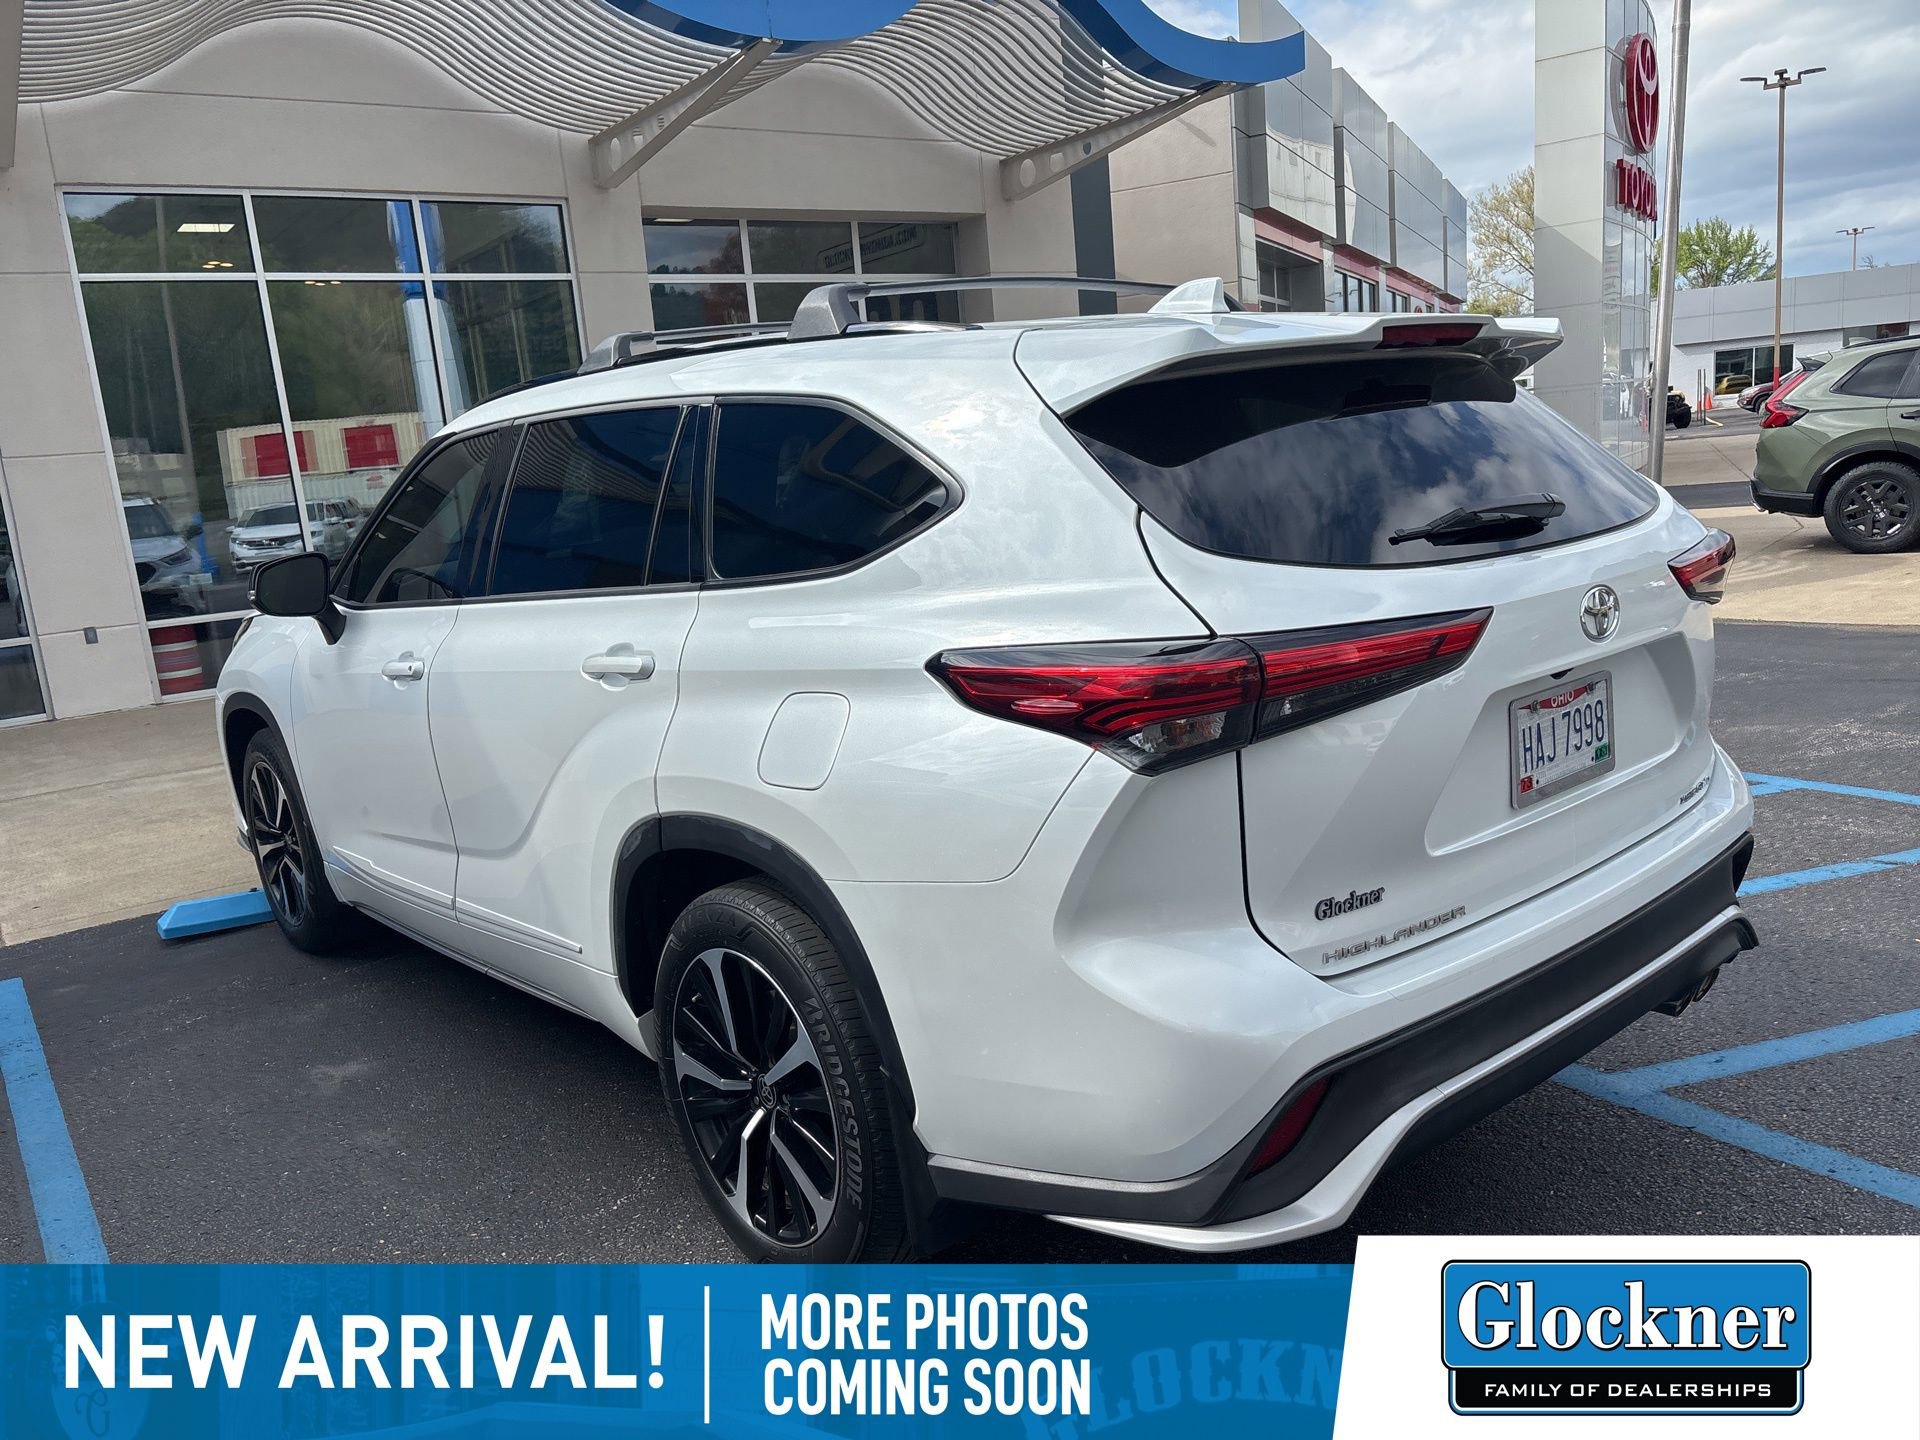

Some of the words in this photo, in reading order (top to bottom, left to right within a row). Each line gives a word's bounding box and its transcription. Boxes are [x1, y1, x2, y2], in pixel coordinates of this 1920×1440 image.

[1616, 158, 1658, 222] TOYO
[1550, 690, 1575, 708] OHIO
[1521, 717, 1557, 773] HAJ
[1561, 699, 1605, 756] 7998
[1314, 886, 1386, 921] Glockner
[1322, 905, 1467, 965] HIGHLANDER
[803, 997, 864, 1211] BRIDGESTONE
